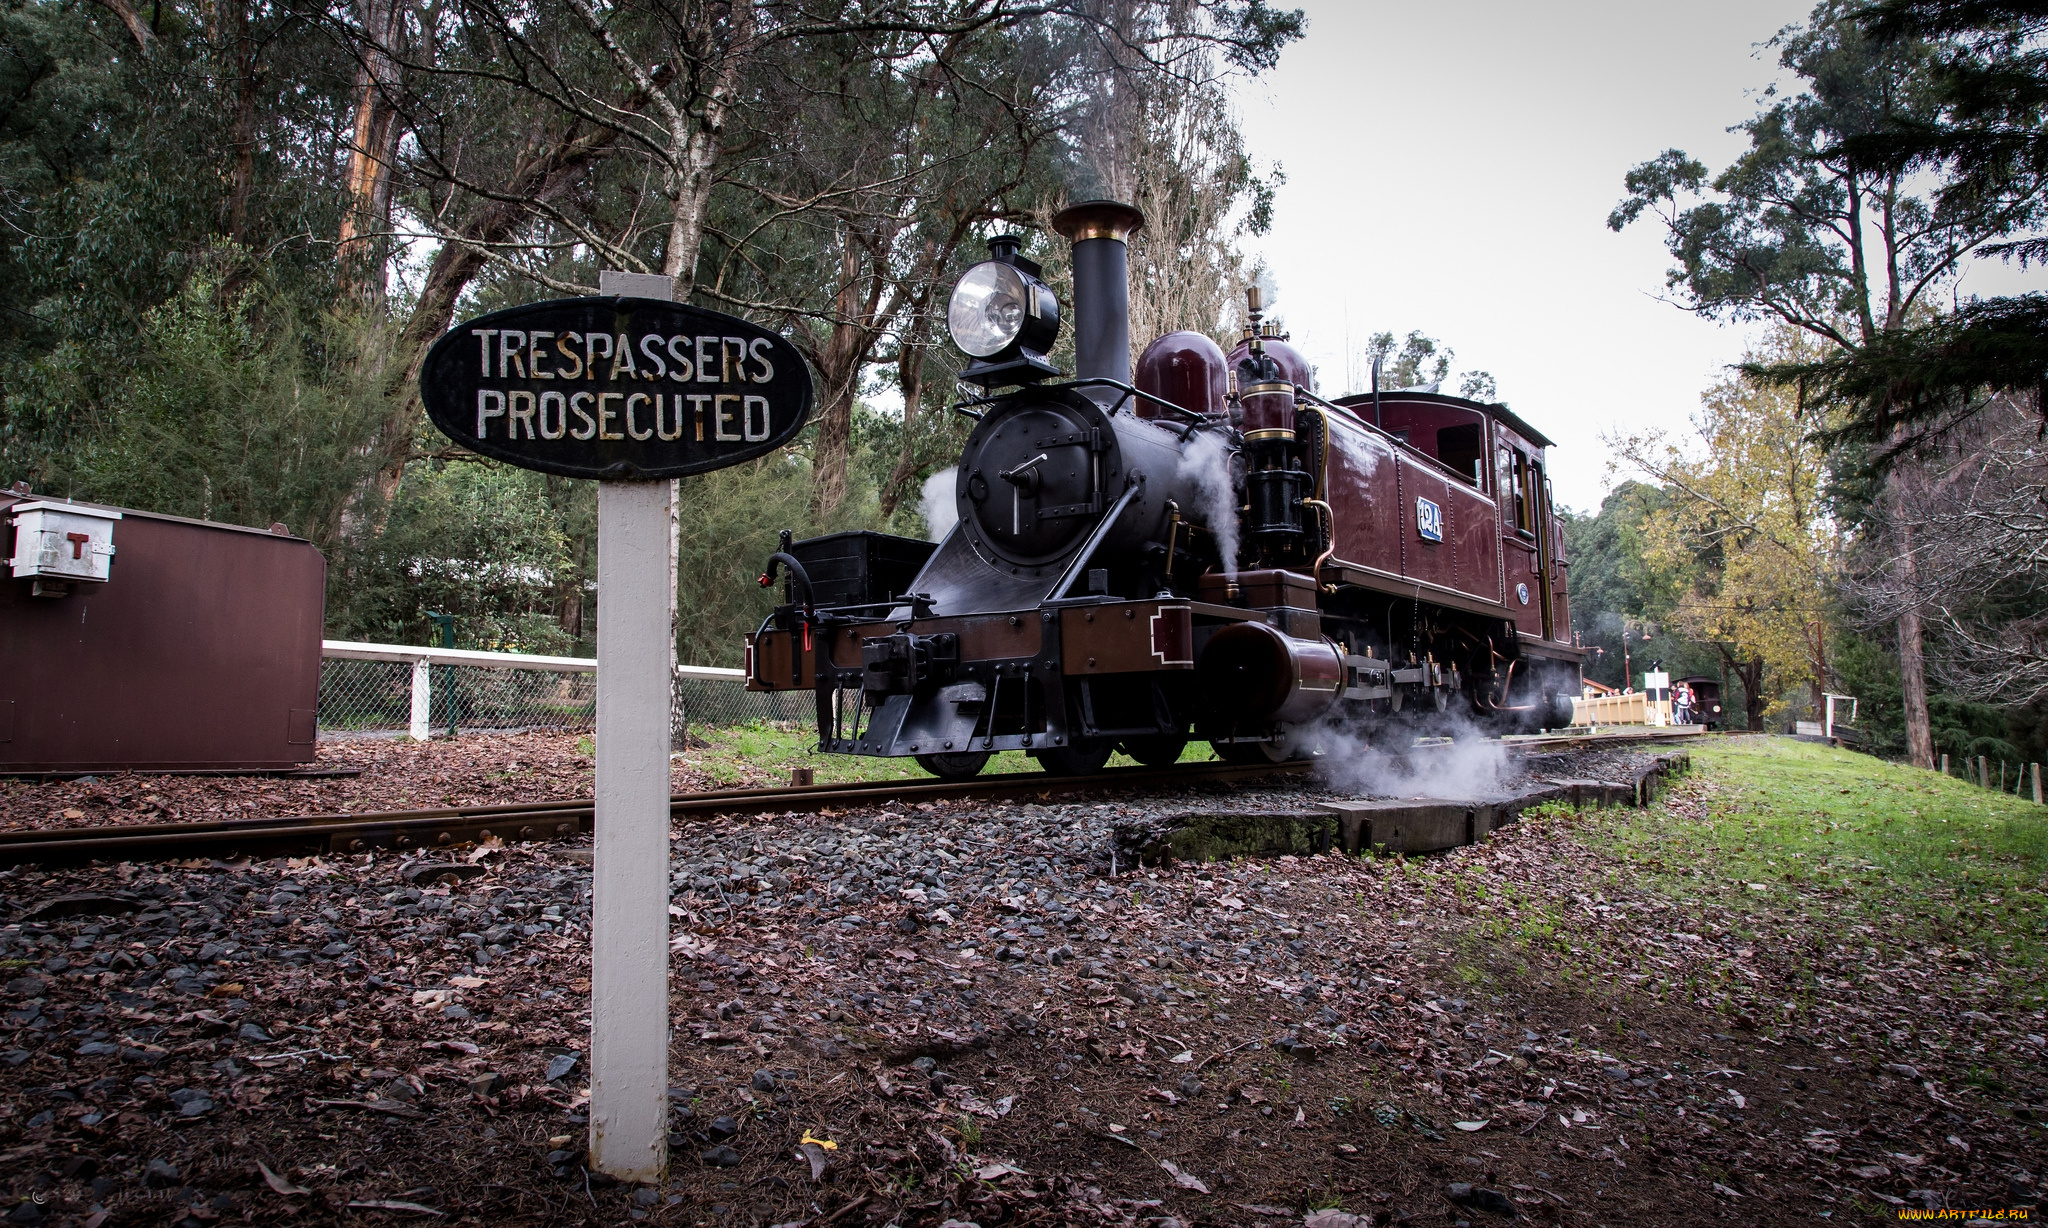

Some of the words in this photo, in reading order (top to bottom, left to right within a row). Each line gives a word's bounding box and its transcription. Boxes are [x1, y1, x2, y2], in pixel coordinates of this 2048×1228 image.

[472, 329, 774, 383] TRESPASSERS
[477, 389, 771, 442] PROSECUTED
[67, 532, 89, 559] T
